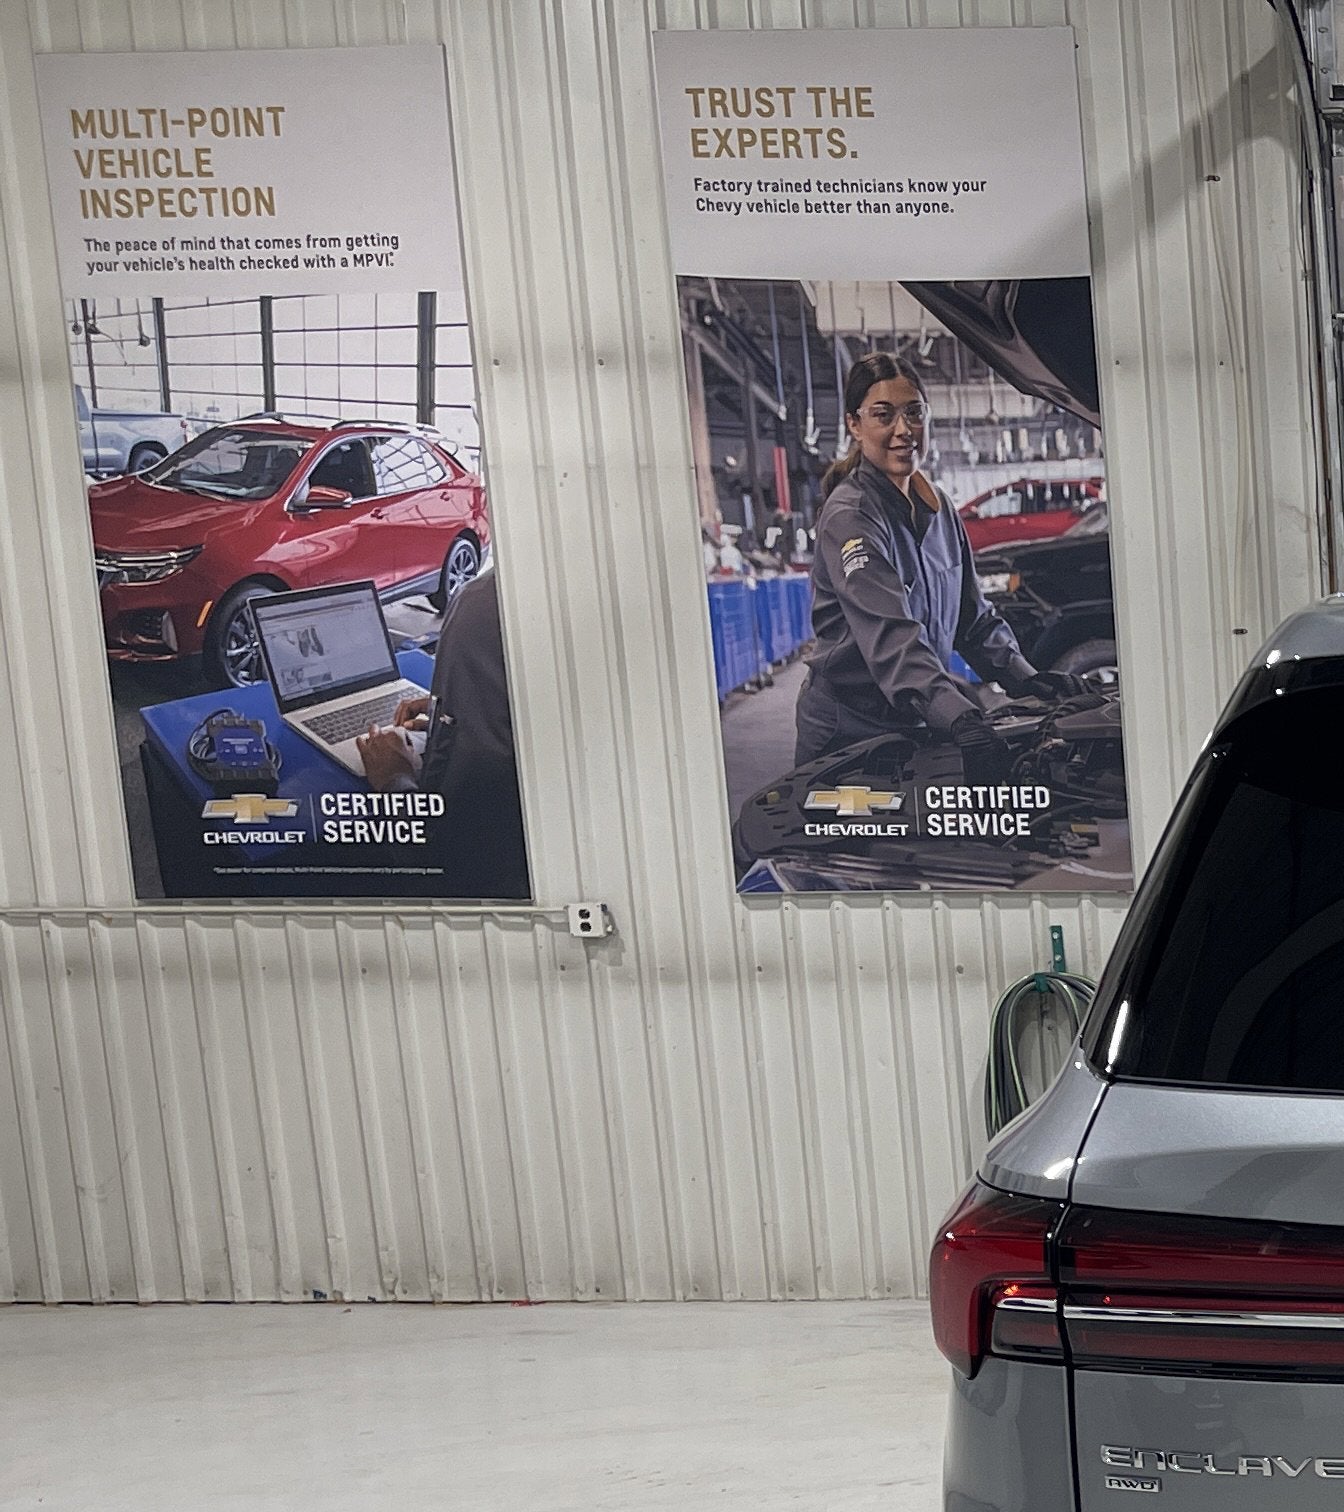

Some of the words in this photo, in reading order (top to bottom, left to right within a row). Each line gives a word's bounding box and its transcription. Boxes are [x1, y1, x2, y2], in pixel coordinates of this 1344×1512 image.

[686, 87, 796, 118] TRUST
[806, 86, 875, 118] THE
[70, 106, 285, 139] MULTI-POINT
[690, 127, 859, 159] EXPERTS.
[75, 148, 214, 179] VEHICLE
[694, 178, 752, 195] Factory
[757, 178, 812, 193] trained
[816, 178, 904, 193] technicians
[908, 178, 948, 193] know
[952, 180, 987, 196] your
[80, 186, 276, 220] INSPECTION
[696, 197, 742, 216] Chevy
[746, 198, 800, 213] vehicle
[805, 199, 852, 214] better
[857, 199, 891, 213] than
[895, 201, 955, 217] anyone.
[84, 237, 111, 253] The
[115, 240, 157, 256] peace
[162, 237, 176, 251] of
[181, 236, 216, 251] mind
[220, 235, 251, 250] that
[255, 237, 301, 250] comes
[306, 234, 341, 249] from
[346, 233, 399, 251] getting
[87, 260, 119, 276] your
[123, 256, 185, 272] vehicle's
[189, 255, 235, 271] health
[239, 255, 299, 270] checked
[303, 253, 336, 269] with
[340, 257, 349, 268] a
[320, 793, 445, 818] CERTIFIED
[925, 786, 1050, 810] CERTIFIED
[323, 820, 426, 844] SERVICE
[804, 823, 909, 837] CHEVROLET
[927, 813, 1032, 837] SERVICE
[203, 831, 306, 845] CHEVROLET
[1107, 1478, 1158, 1491] AWD
